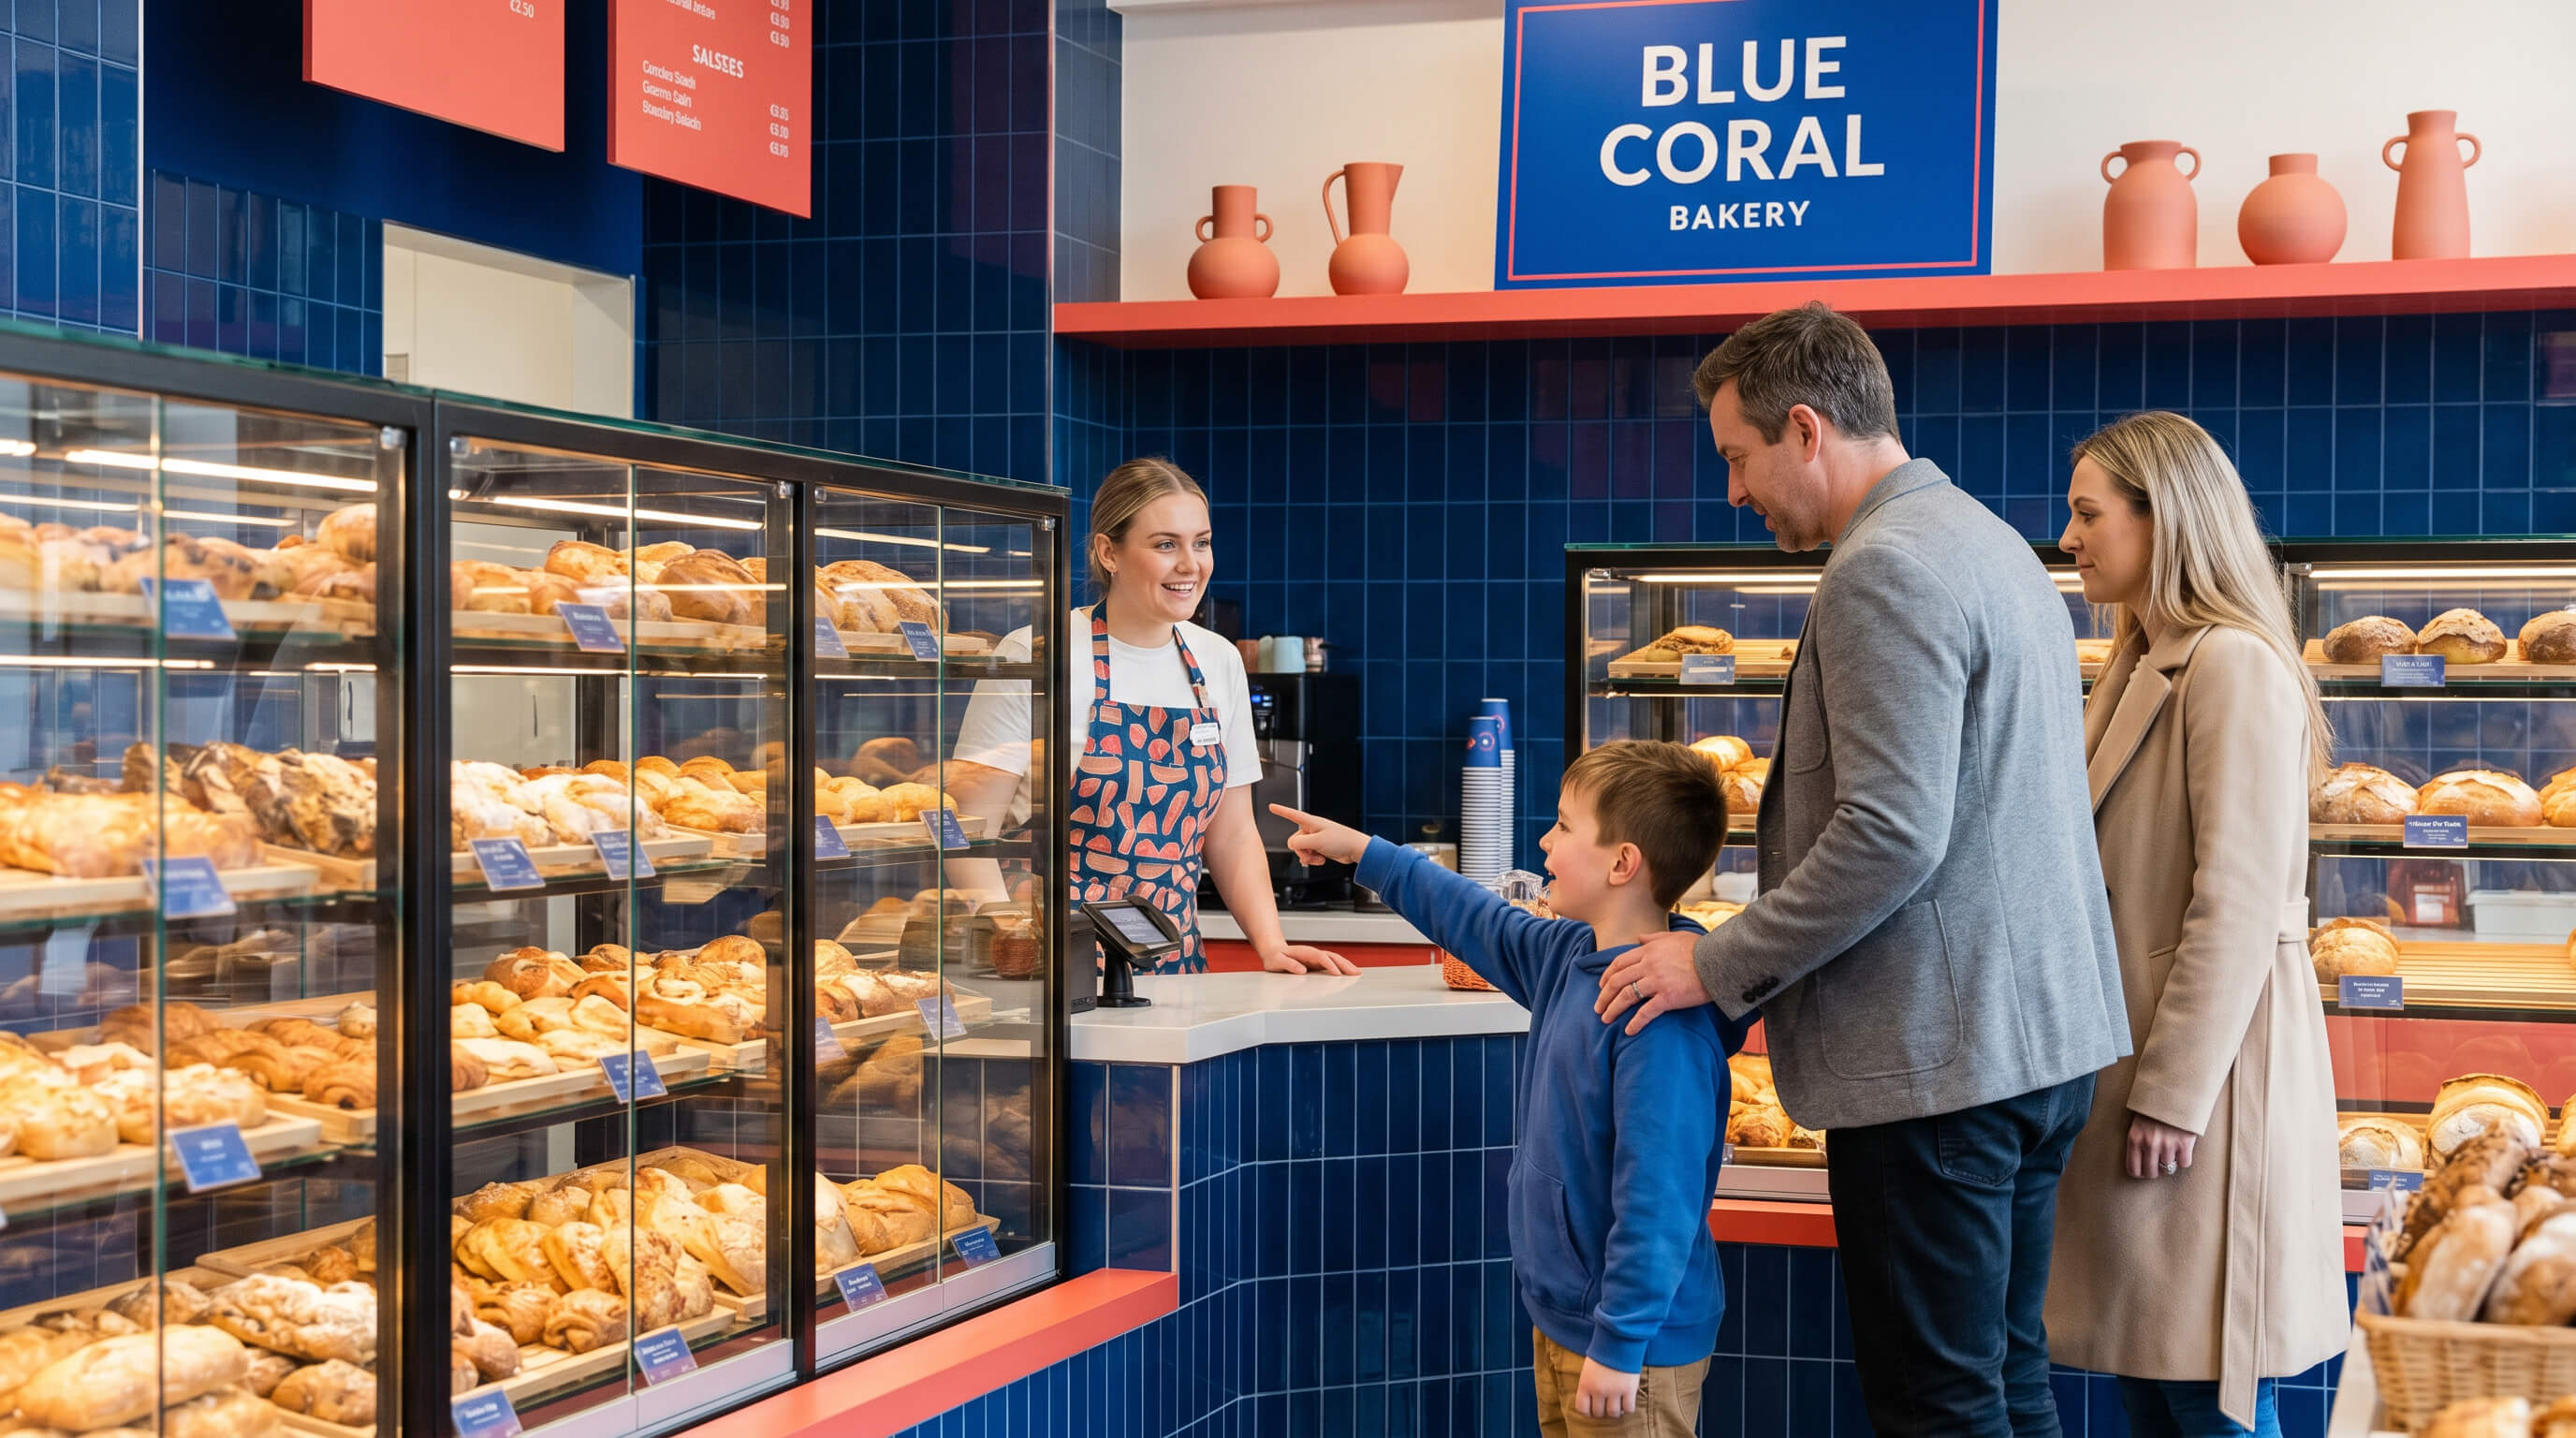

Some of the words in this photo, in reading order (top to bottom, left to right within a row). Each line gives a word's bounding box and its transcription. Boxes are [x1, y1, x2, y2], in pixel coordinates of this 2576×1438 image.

[1642, 37, 1847, 108] BLUE
[1600, 113, 1885, 186] CORAL
[1670, 200, 1810, 231] BAKERY
